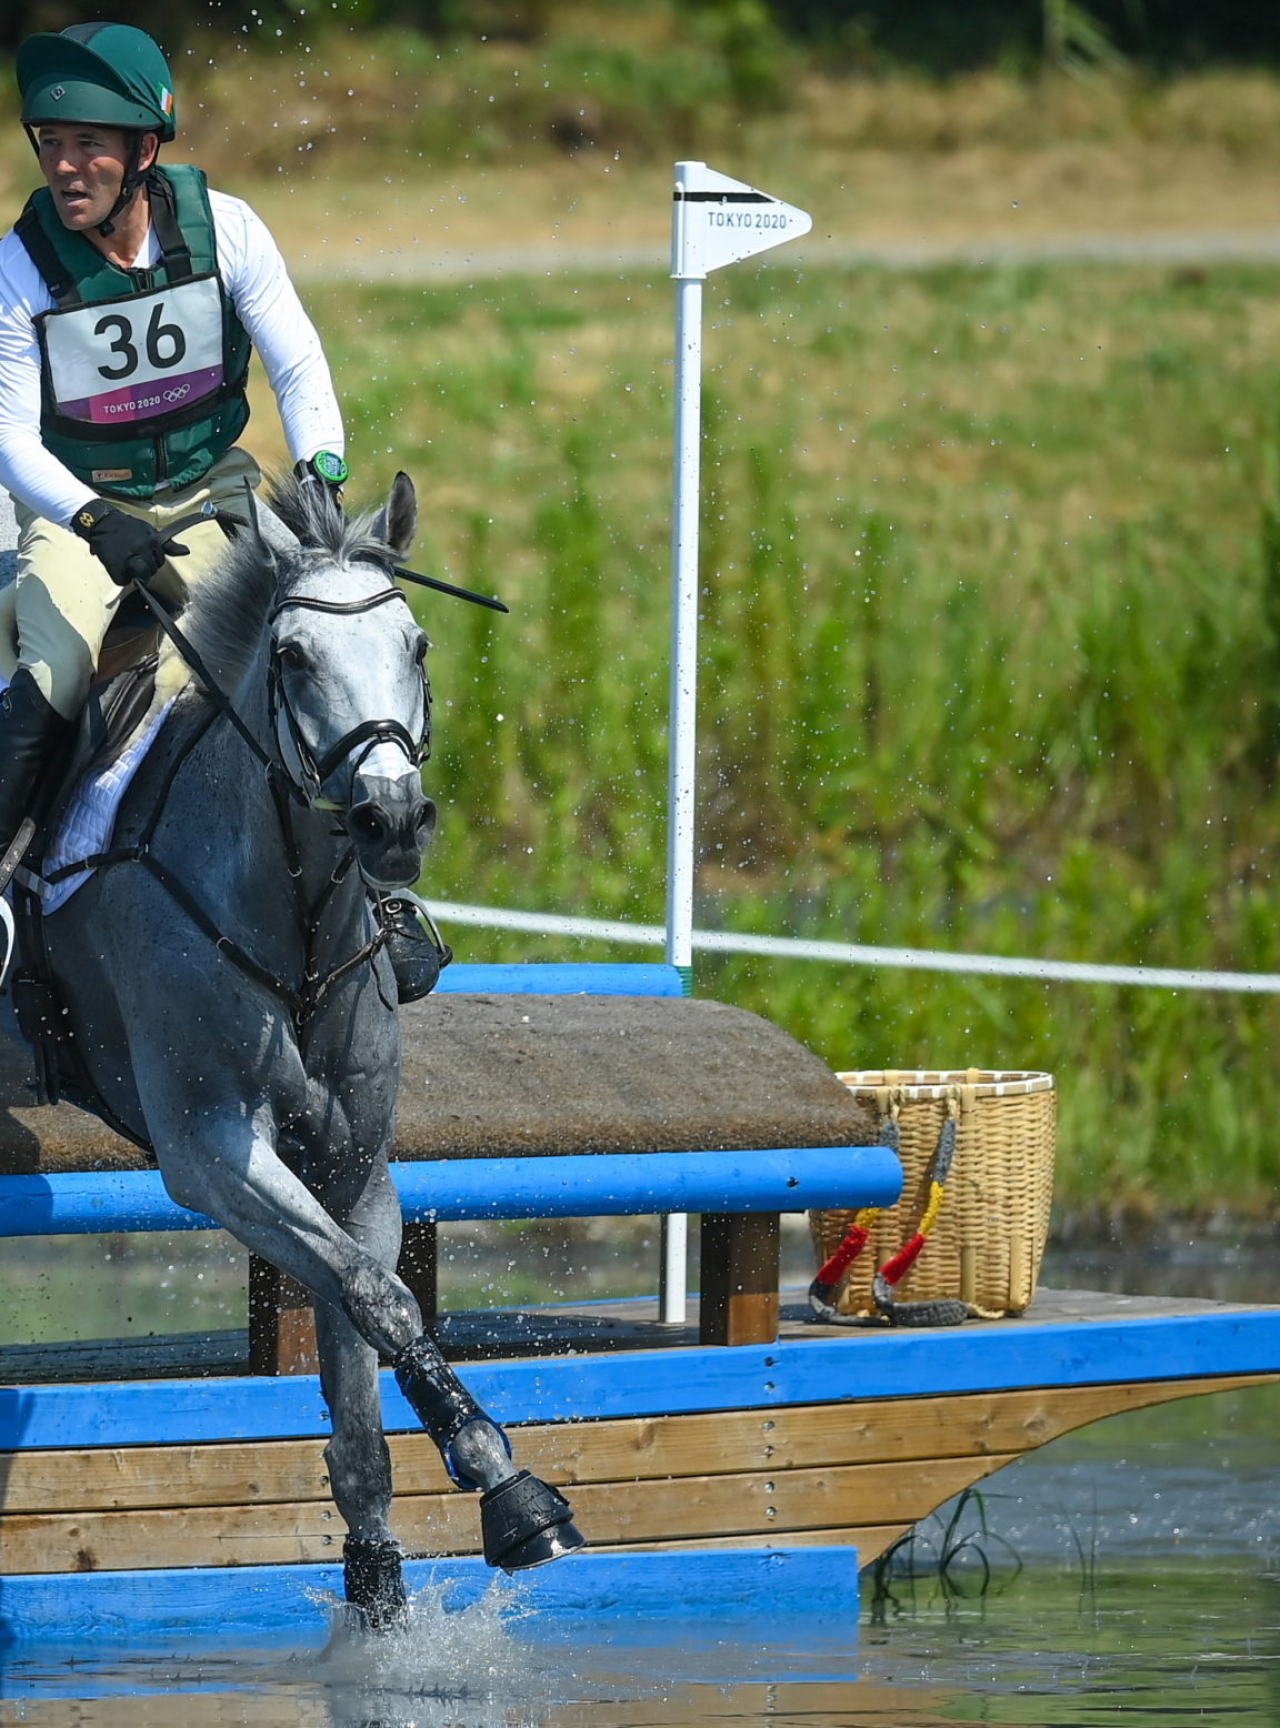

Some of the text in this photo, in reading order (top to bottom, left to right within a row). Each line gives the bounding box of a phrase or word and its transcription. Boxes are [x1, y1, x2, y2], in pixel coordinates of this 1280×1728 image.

[708, 212, 787, 229] TOKYO 2020
[94, 302, 187, 380] 36
[104, 396, 161, 414] TOKYO 2020
